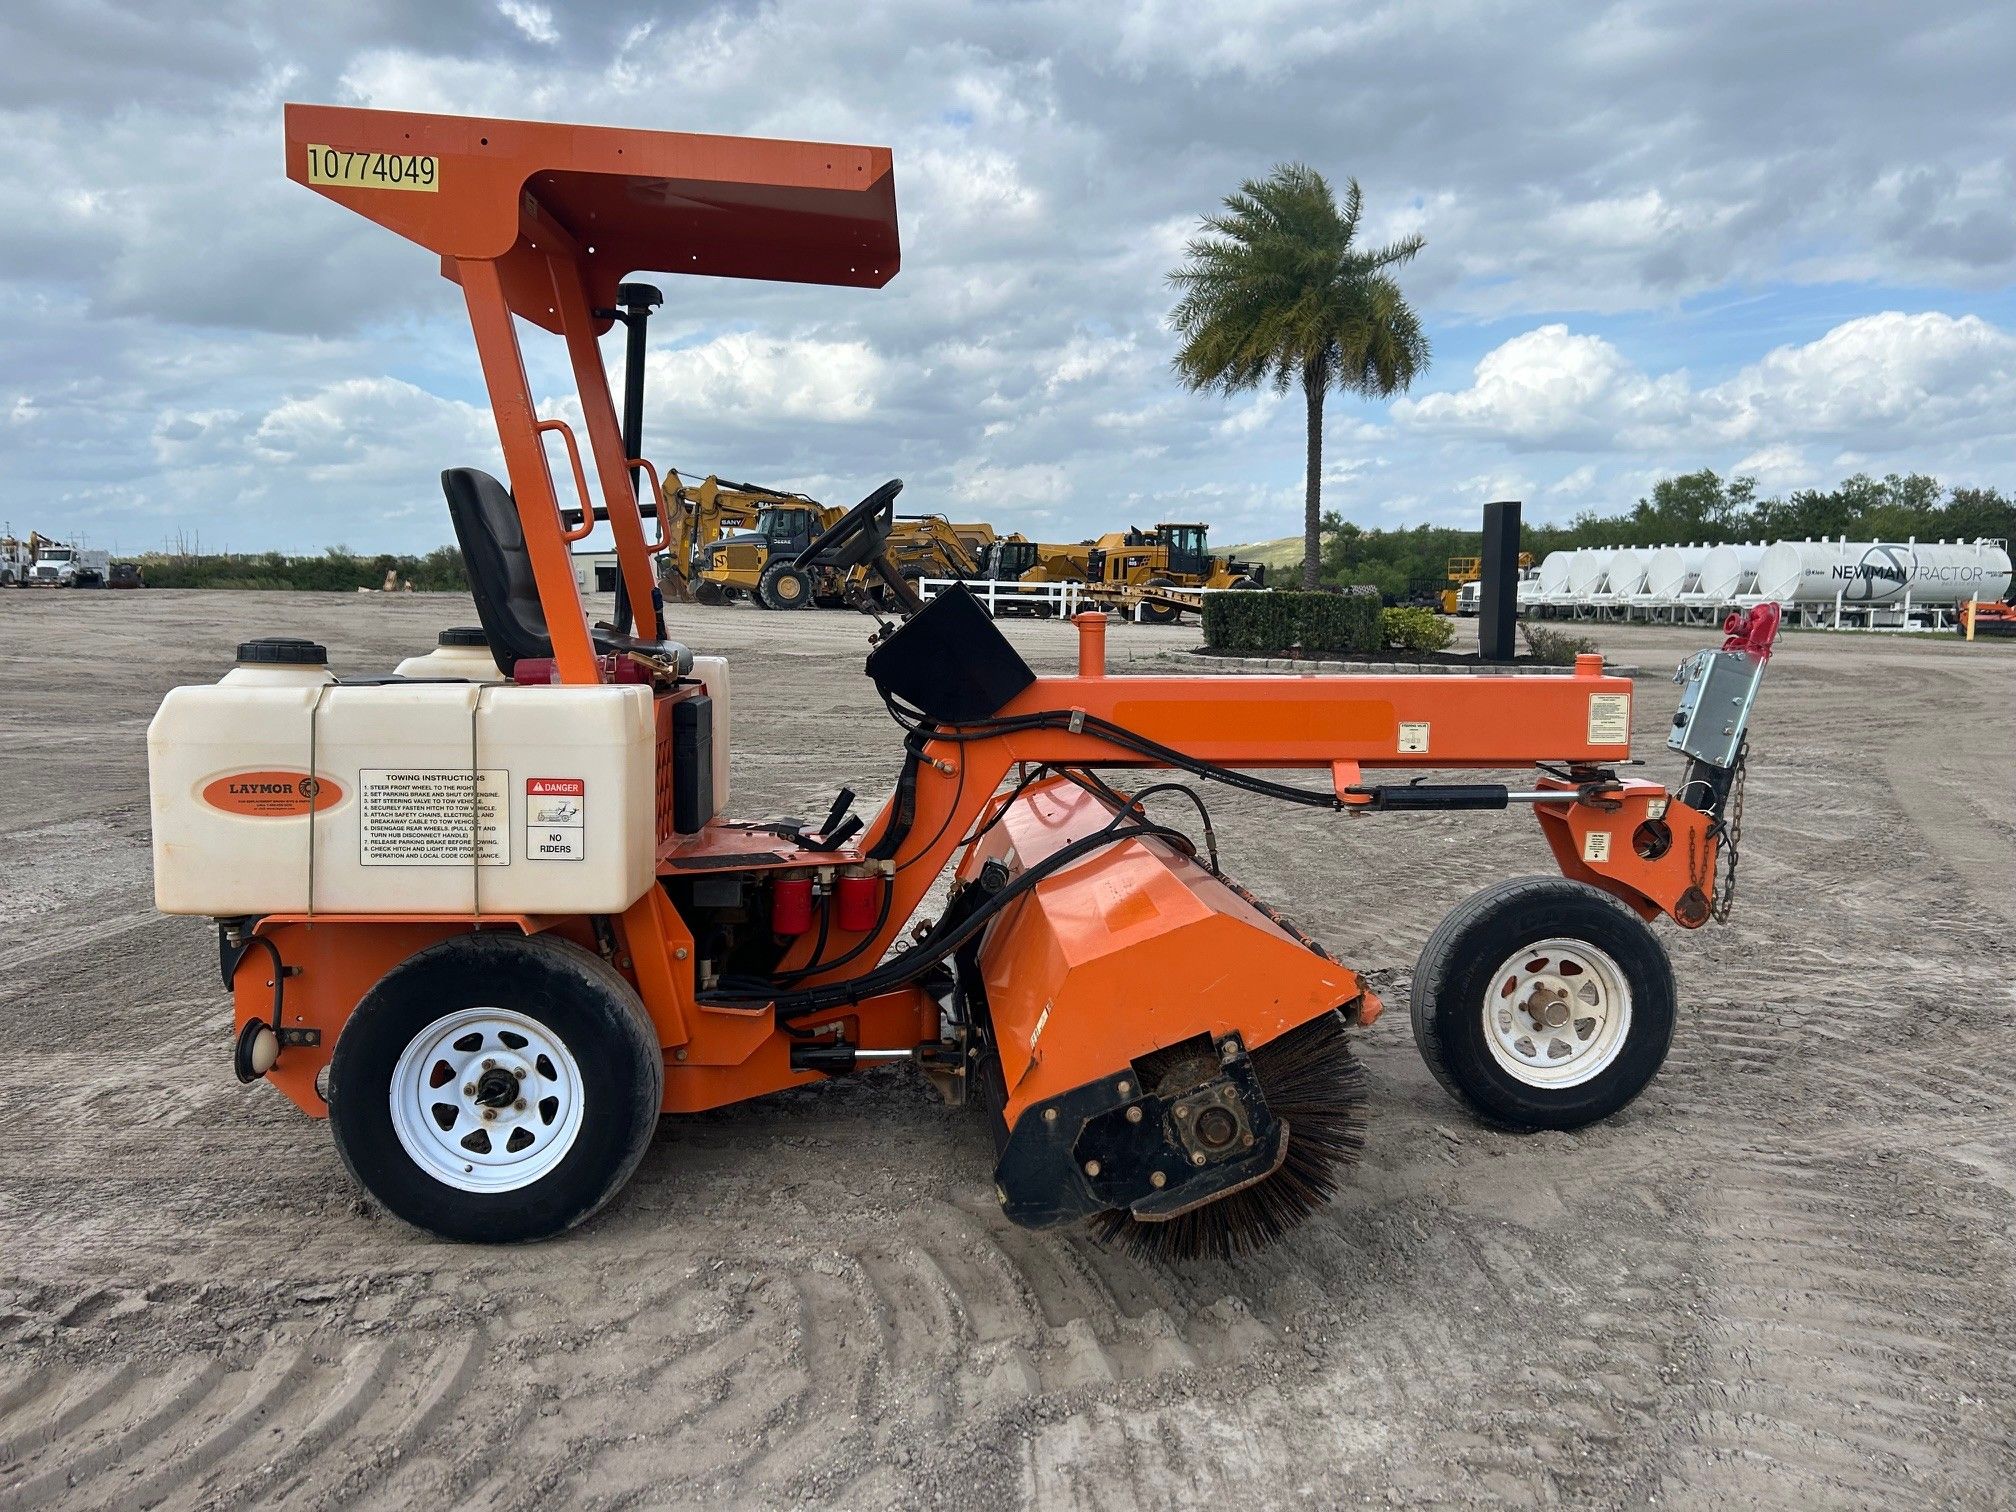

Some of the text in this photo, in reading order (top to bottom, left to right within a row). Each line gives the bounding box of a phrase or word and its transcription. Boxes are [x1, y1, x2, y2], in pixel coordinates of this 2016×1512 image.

[309, 149, 435, 185] 10774049
[1832, 565, 1983, 581] NEWMAN TRACTOR
[230, 784, 293, 794] LAYMOR
[544, 783, 579, 792] DANGER
[549, 834, 562, 842] NO
[540, 845, 572, 854] RIDERS
